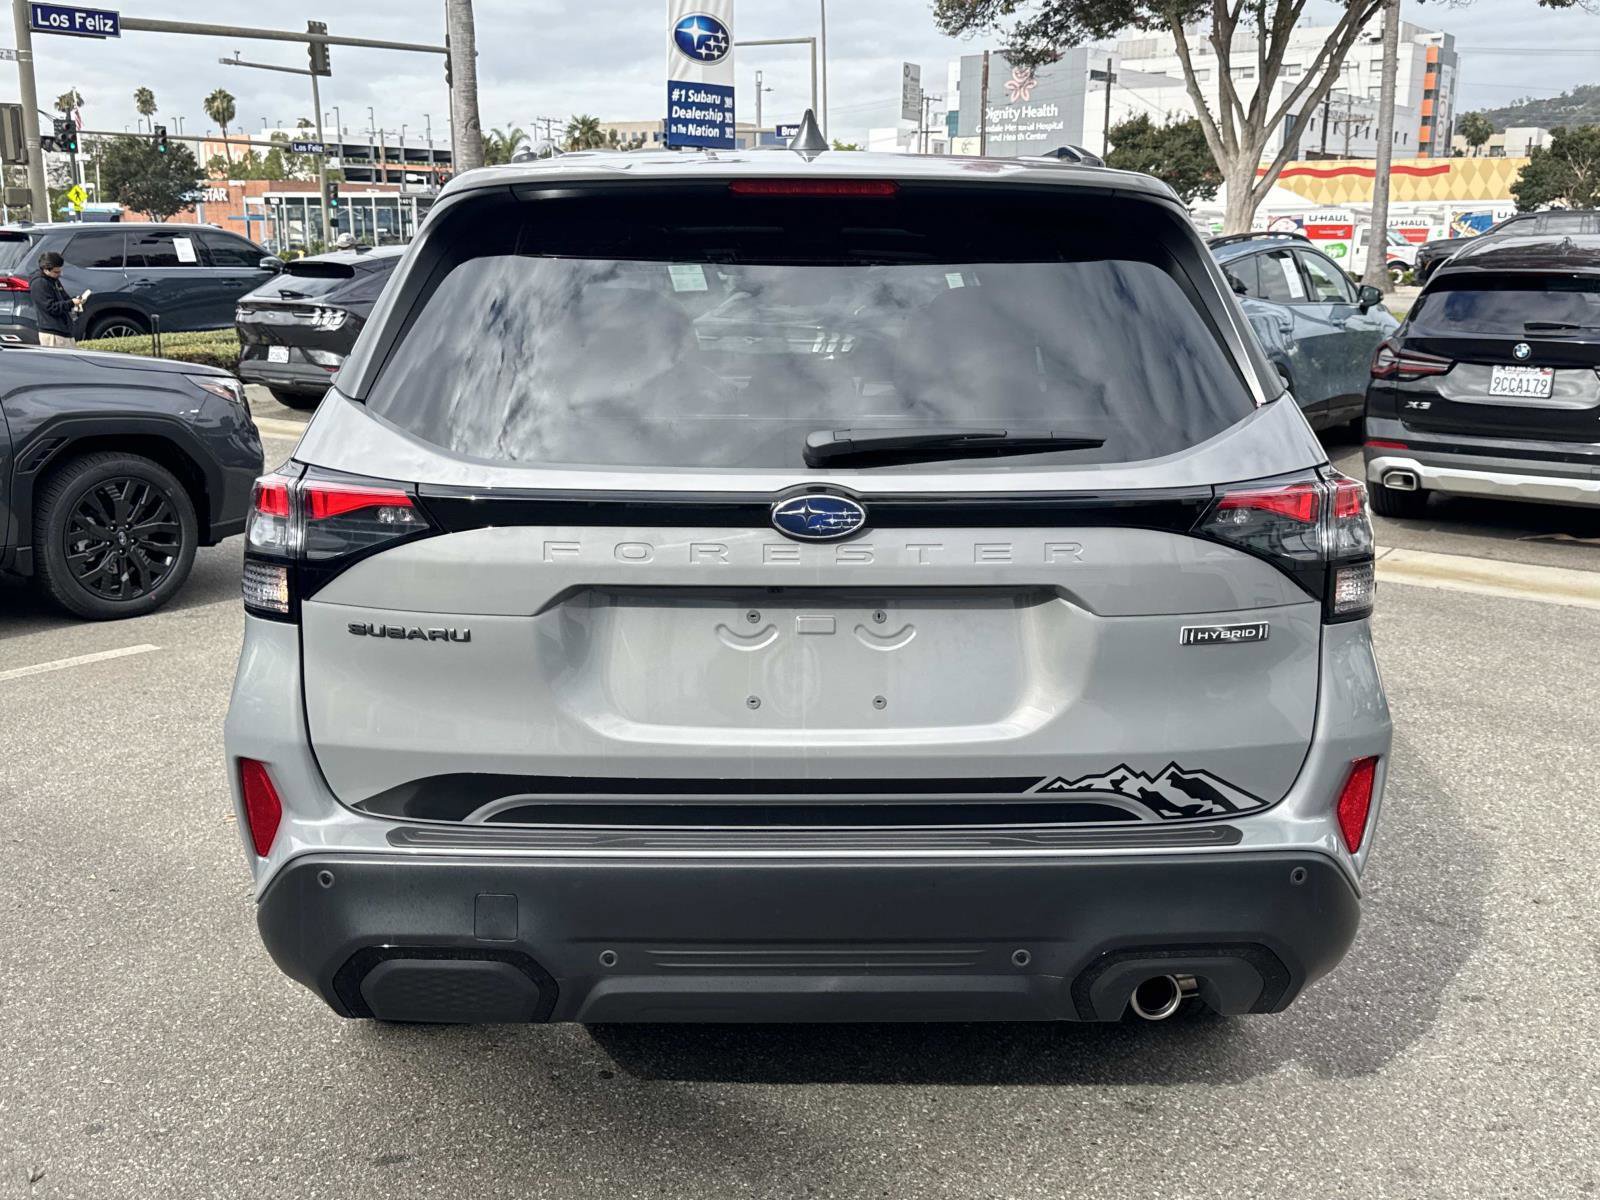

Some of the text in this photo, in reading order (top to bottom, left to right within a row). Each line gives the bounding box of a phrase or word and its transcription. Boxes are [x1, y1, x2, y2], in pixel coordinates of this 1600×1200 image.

[36, 8, 115, 32] Los Feliz
[671, 88, 686, 102] #1
[687, 90, 721, 104] Subaru
[672, 106, 724, 124] Dealership
[1021, 103, 1059, 118] Health
[687, 124, 720, 138] Nation
[781, 126, 799, 136] Bran
[293, 143, 324, 153] Los Feliz
[202, 187, 229, 202] STAR
[1492, 376, 1549, 395] 9CCA179
[1404, 401, 1432, 410] X3
[543, 540, 1085, 565] FORESTER
[347, 622, 472, 643] SUBARU
[1197, 628, 1256, 640] HYBRID
